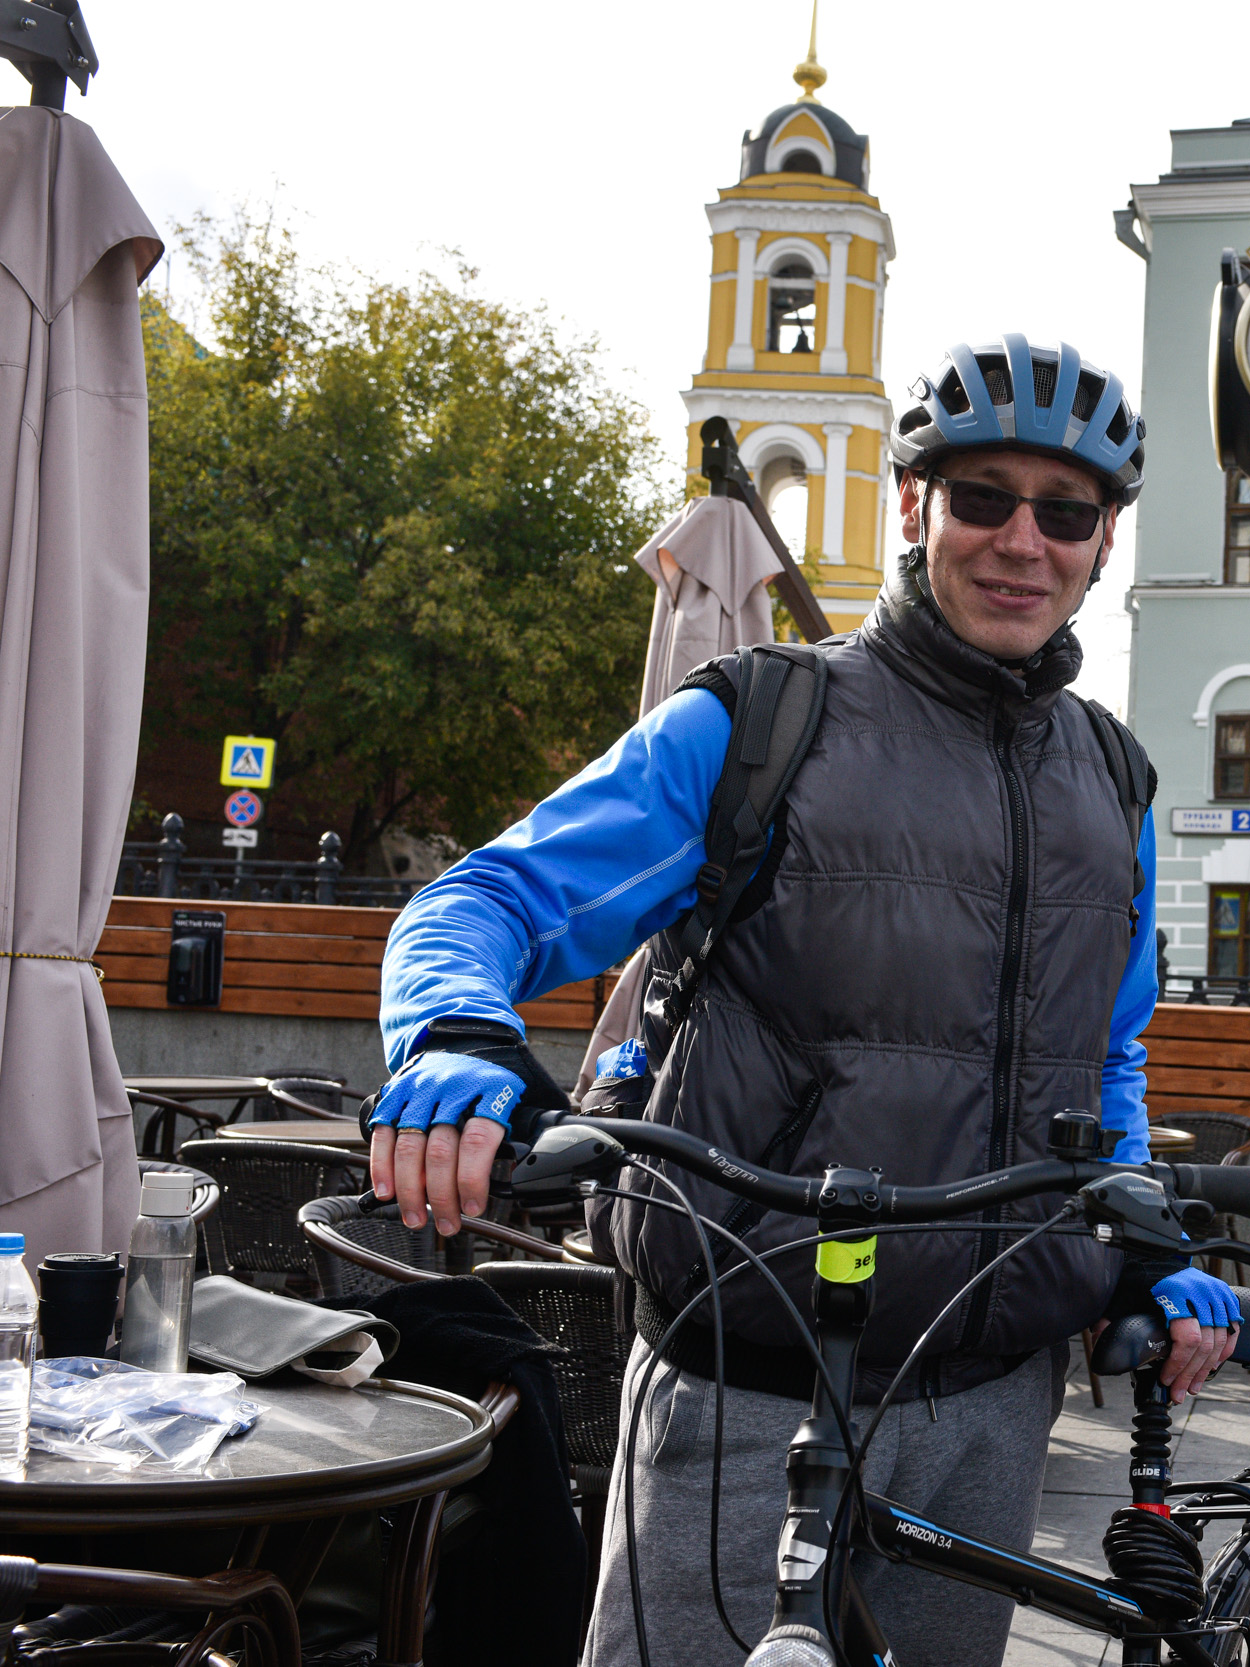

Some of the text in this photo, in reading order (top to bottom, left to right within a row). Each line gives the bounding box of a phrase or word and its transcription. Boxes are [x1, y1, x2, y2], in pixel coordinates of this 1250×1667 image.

[1237, 812, 1250, 829] 2
[896, 1520, 953, 1549] HORIZON 3.4
